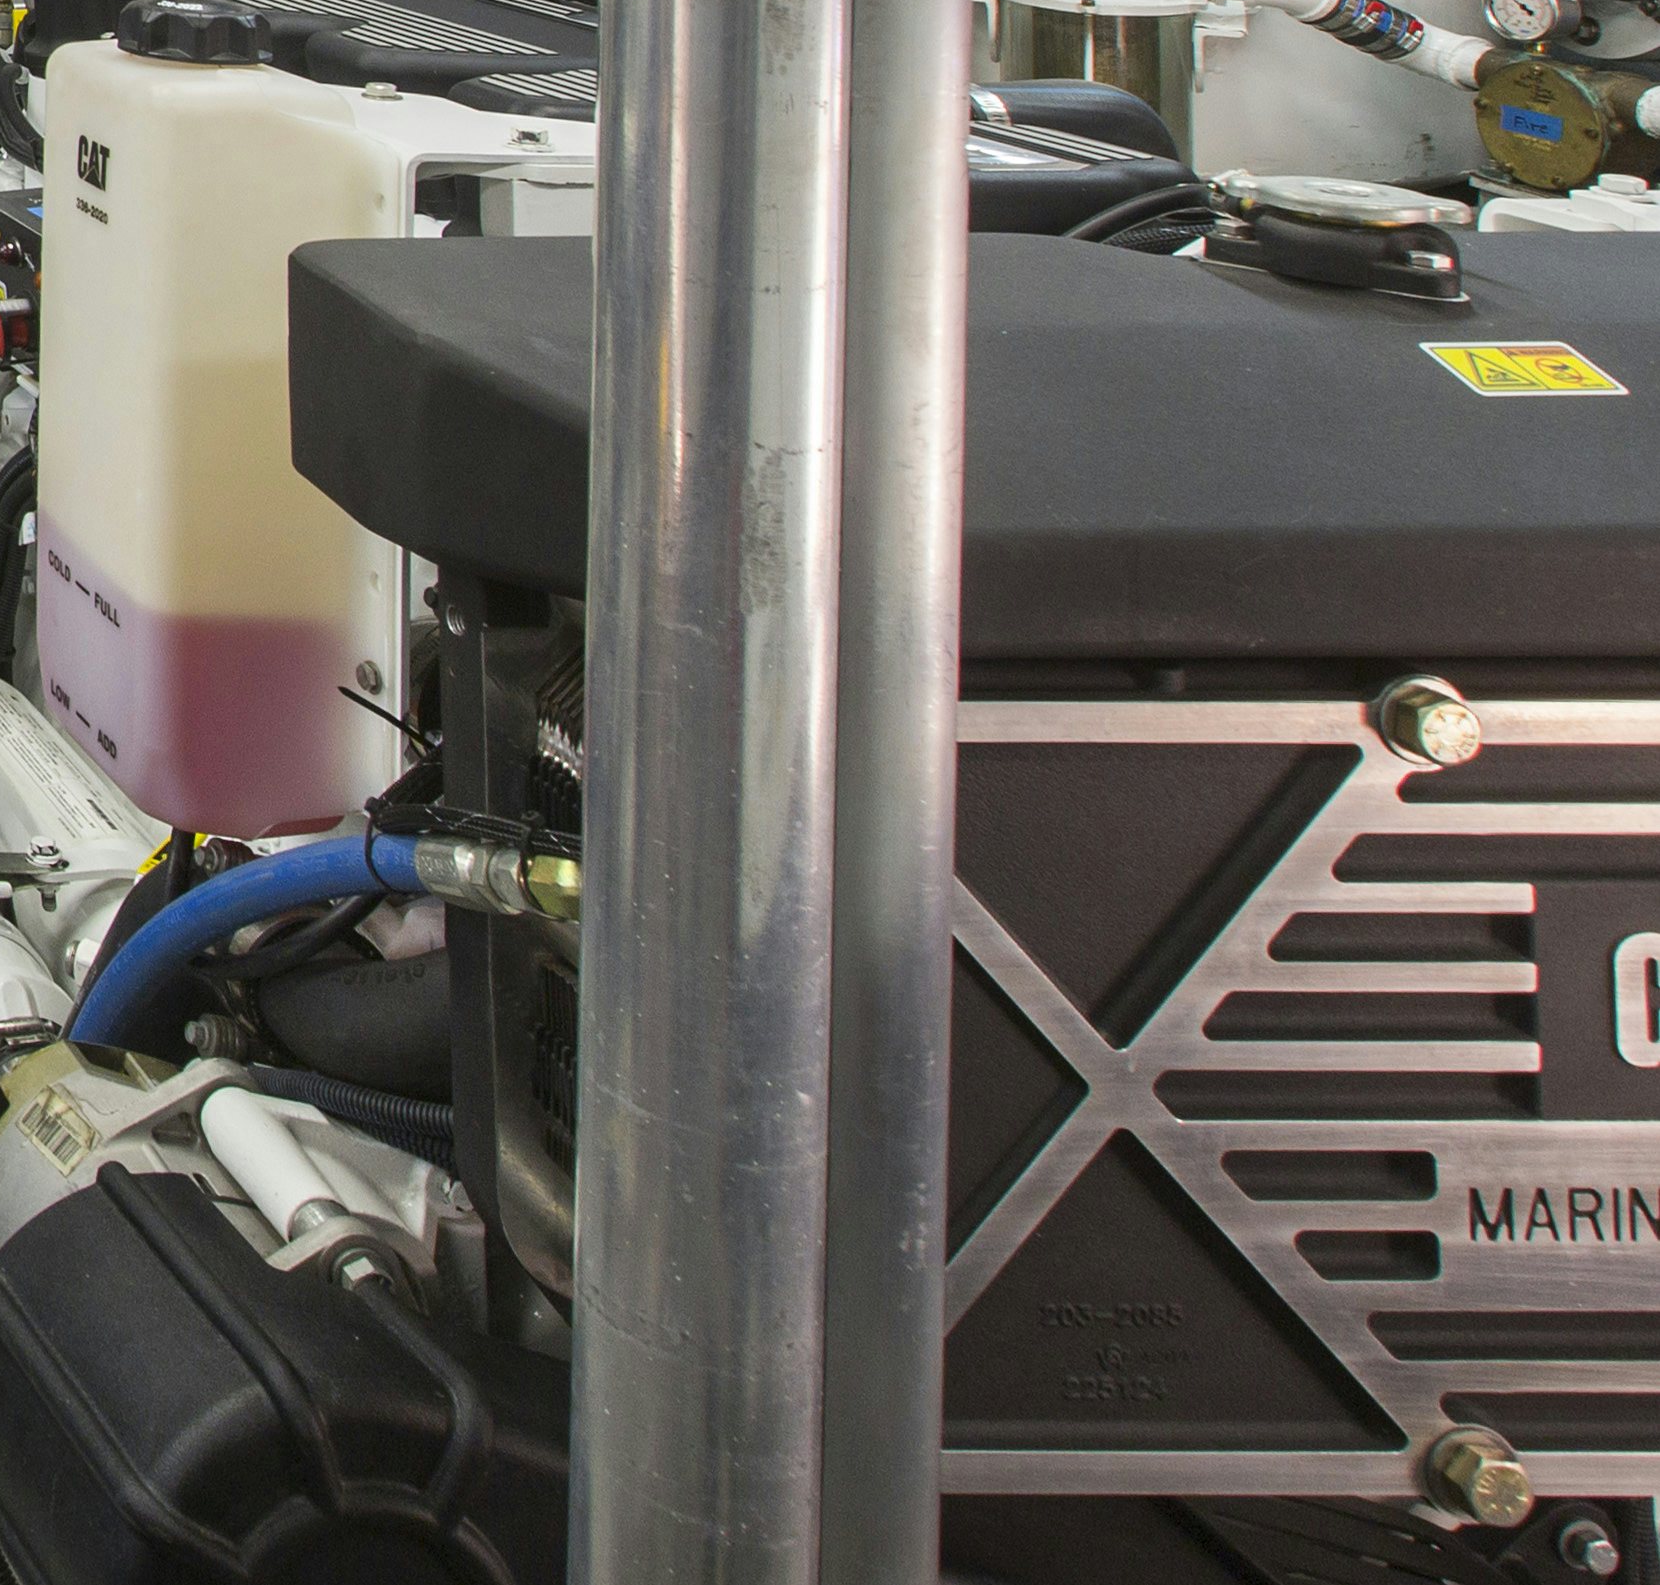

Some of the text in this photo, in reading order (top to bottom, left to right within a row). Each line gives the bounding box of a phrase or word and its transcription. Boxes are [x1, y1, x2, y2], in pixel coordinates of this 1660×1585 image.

[1513, 116, 1549, 135] Fire
[77, 133, 112, 193] CAT
[47, 549, 120, 628] COLD FULL
[50, 678, 118, 760] LOW ADD
[1468, 1186, 1660, 1243] MARIN
